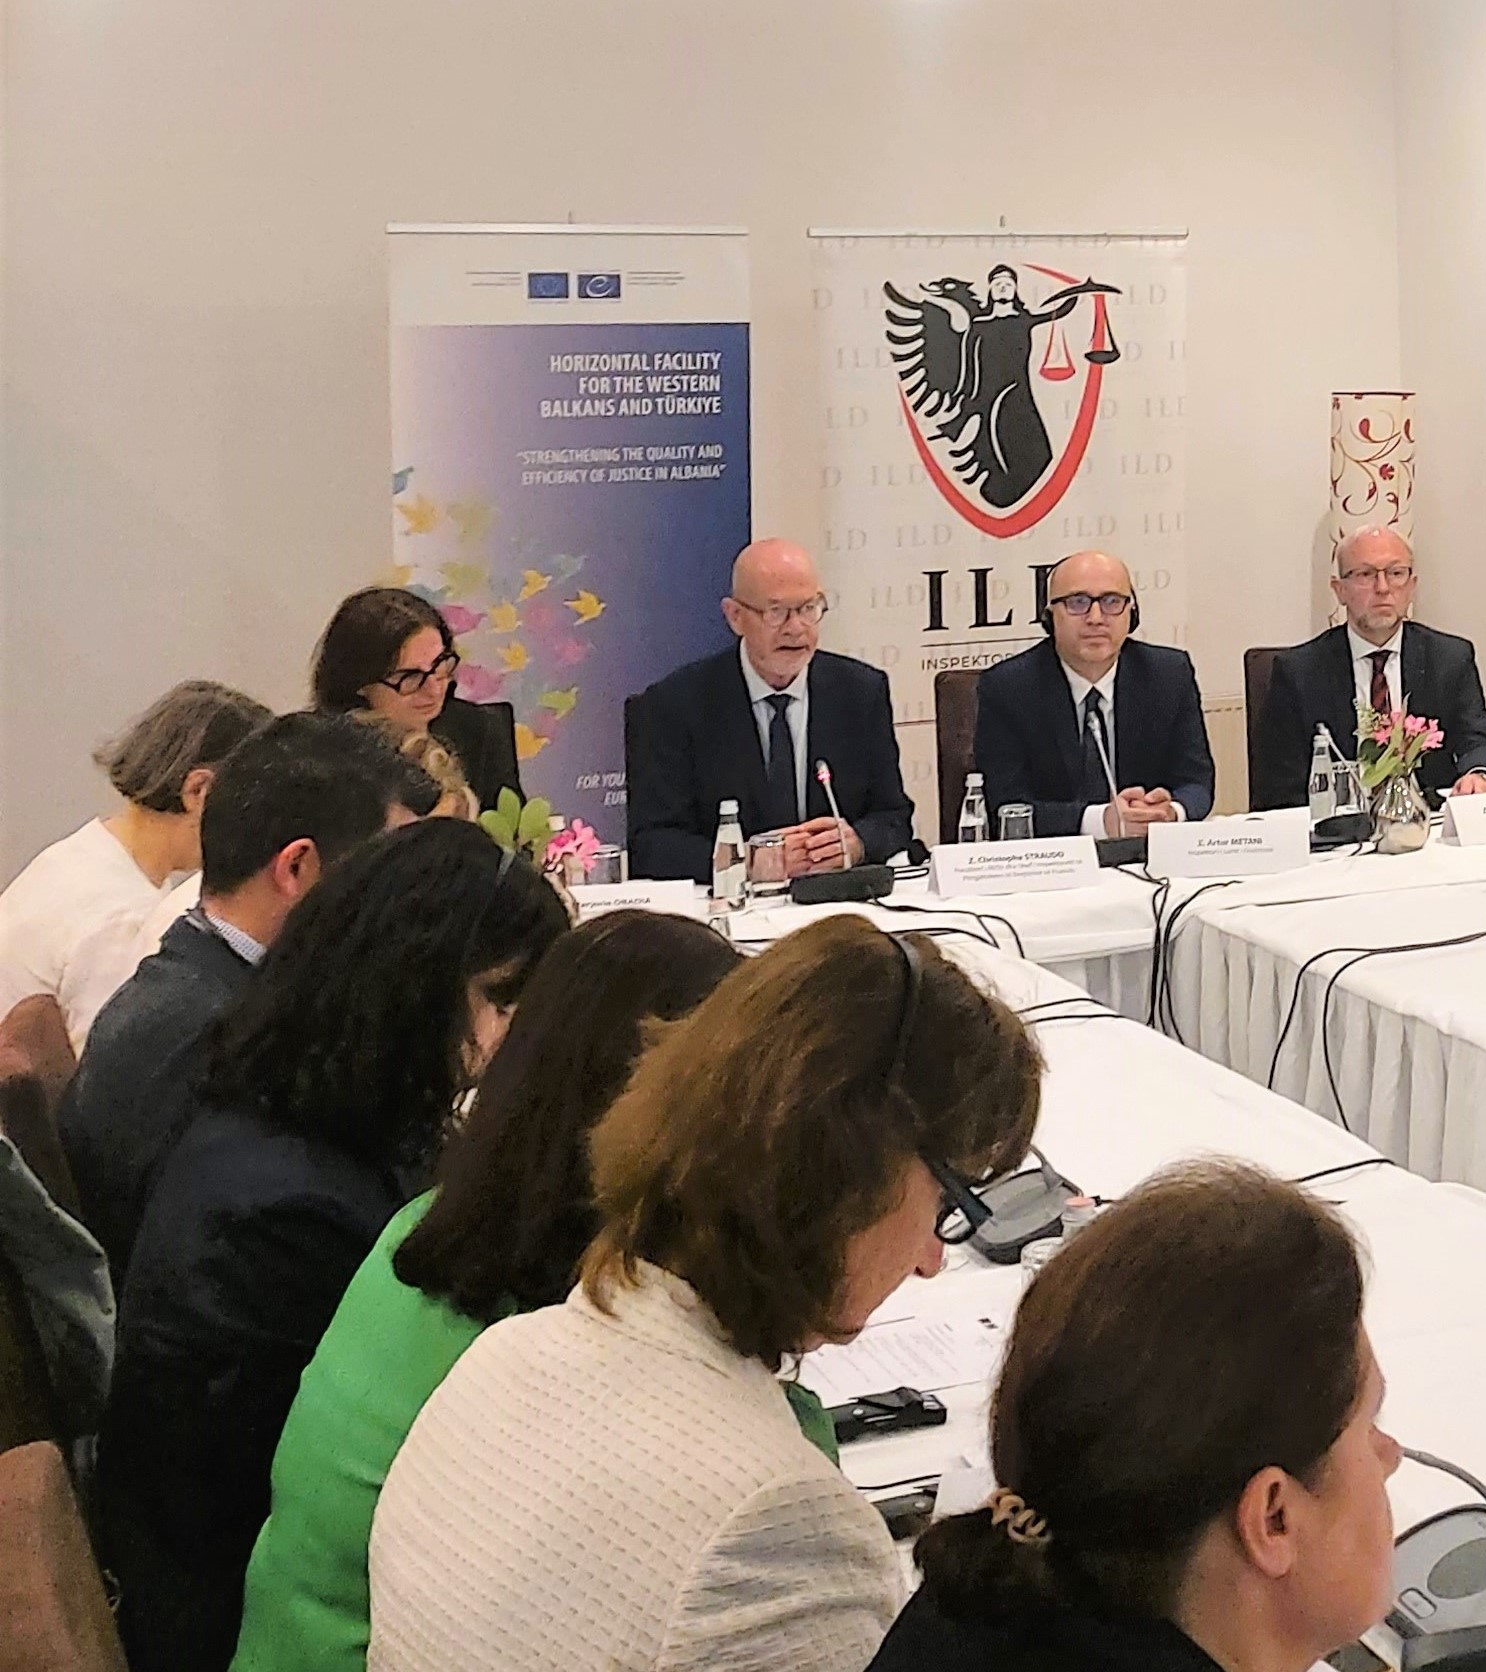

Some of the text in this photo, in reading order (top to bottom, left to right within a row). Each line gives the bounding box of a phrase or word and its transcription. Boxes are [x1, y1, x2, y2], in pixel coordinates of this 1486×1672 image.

[550, 352, 722, 373] HORIZONTAL FACILITY
[578, 374, 721, 394] FOR THE WESTERN
[540, 400, 616, 418] BALKANS
[618, 399, 653, 415] AND
[621, 447, 644, 462] THE
[646, 445, 696, 462] QUALITY
[697, 444, 723, 460] AND
[521, 469, 588, 486] EFFICIENCY
[589, 468, 605, 484] OF
[607, 467, 652, 483] JUSTICE
[654, 466, 669, 481] IN
[896, 523, 953, 548] ILD
[1062, 515, 1118, 539] ILD
[576, 774, 600, 789] FOR
